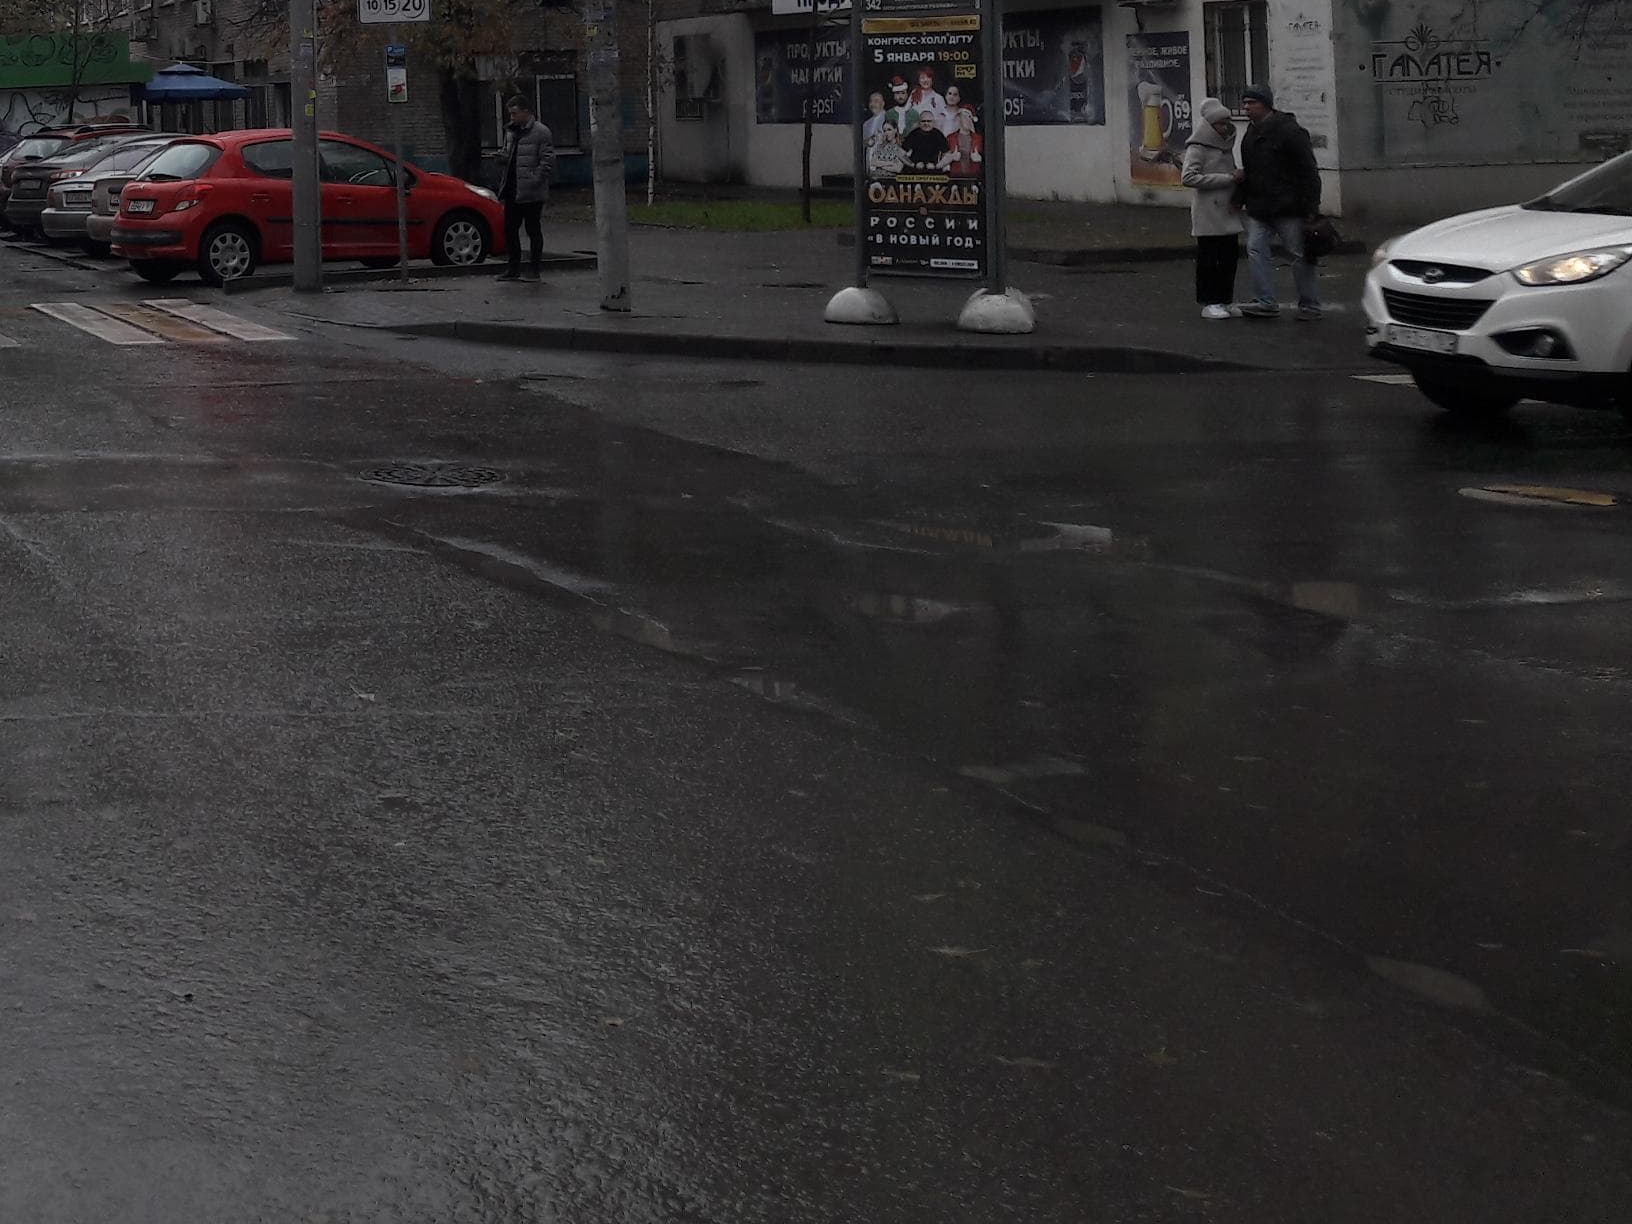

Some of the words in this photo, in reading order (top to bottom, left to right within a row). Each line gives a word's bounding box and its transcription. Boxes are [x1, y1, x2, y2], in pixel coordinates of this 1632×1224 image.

[367, 0, 378, 10] 10
[384, 0, 396, 10] 15
[868, 35, 946, 46] КОНГРЕСС-ХОЛЛ
[948, 34, 974, 45] ДГТУ
[1003, 29, 1044, 50] УКТЫ,
[874, 49, 883, 63] 5
[886, 51, 935, 63] ЯНВАРЯ
[938, 51, 969, 61] 19:00
[1372, 51, 1491, 77] ГАЛАТЕЯ
[1003, 94, 1024, 121] psi
[1174, 101, 1190, 119] 69
[868, 182, 979, 205] ОДНАЖДЫ
[870, 216, 978, 230] РОССИИ
[890, 234, 940, 246] НОВЫЙ
[947, 236, 981, 248] ГОД»
